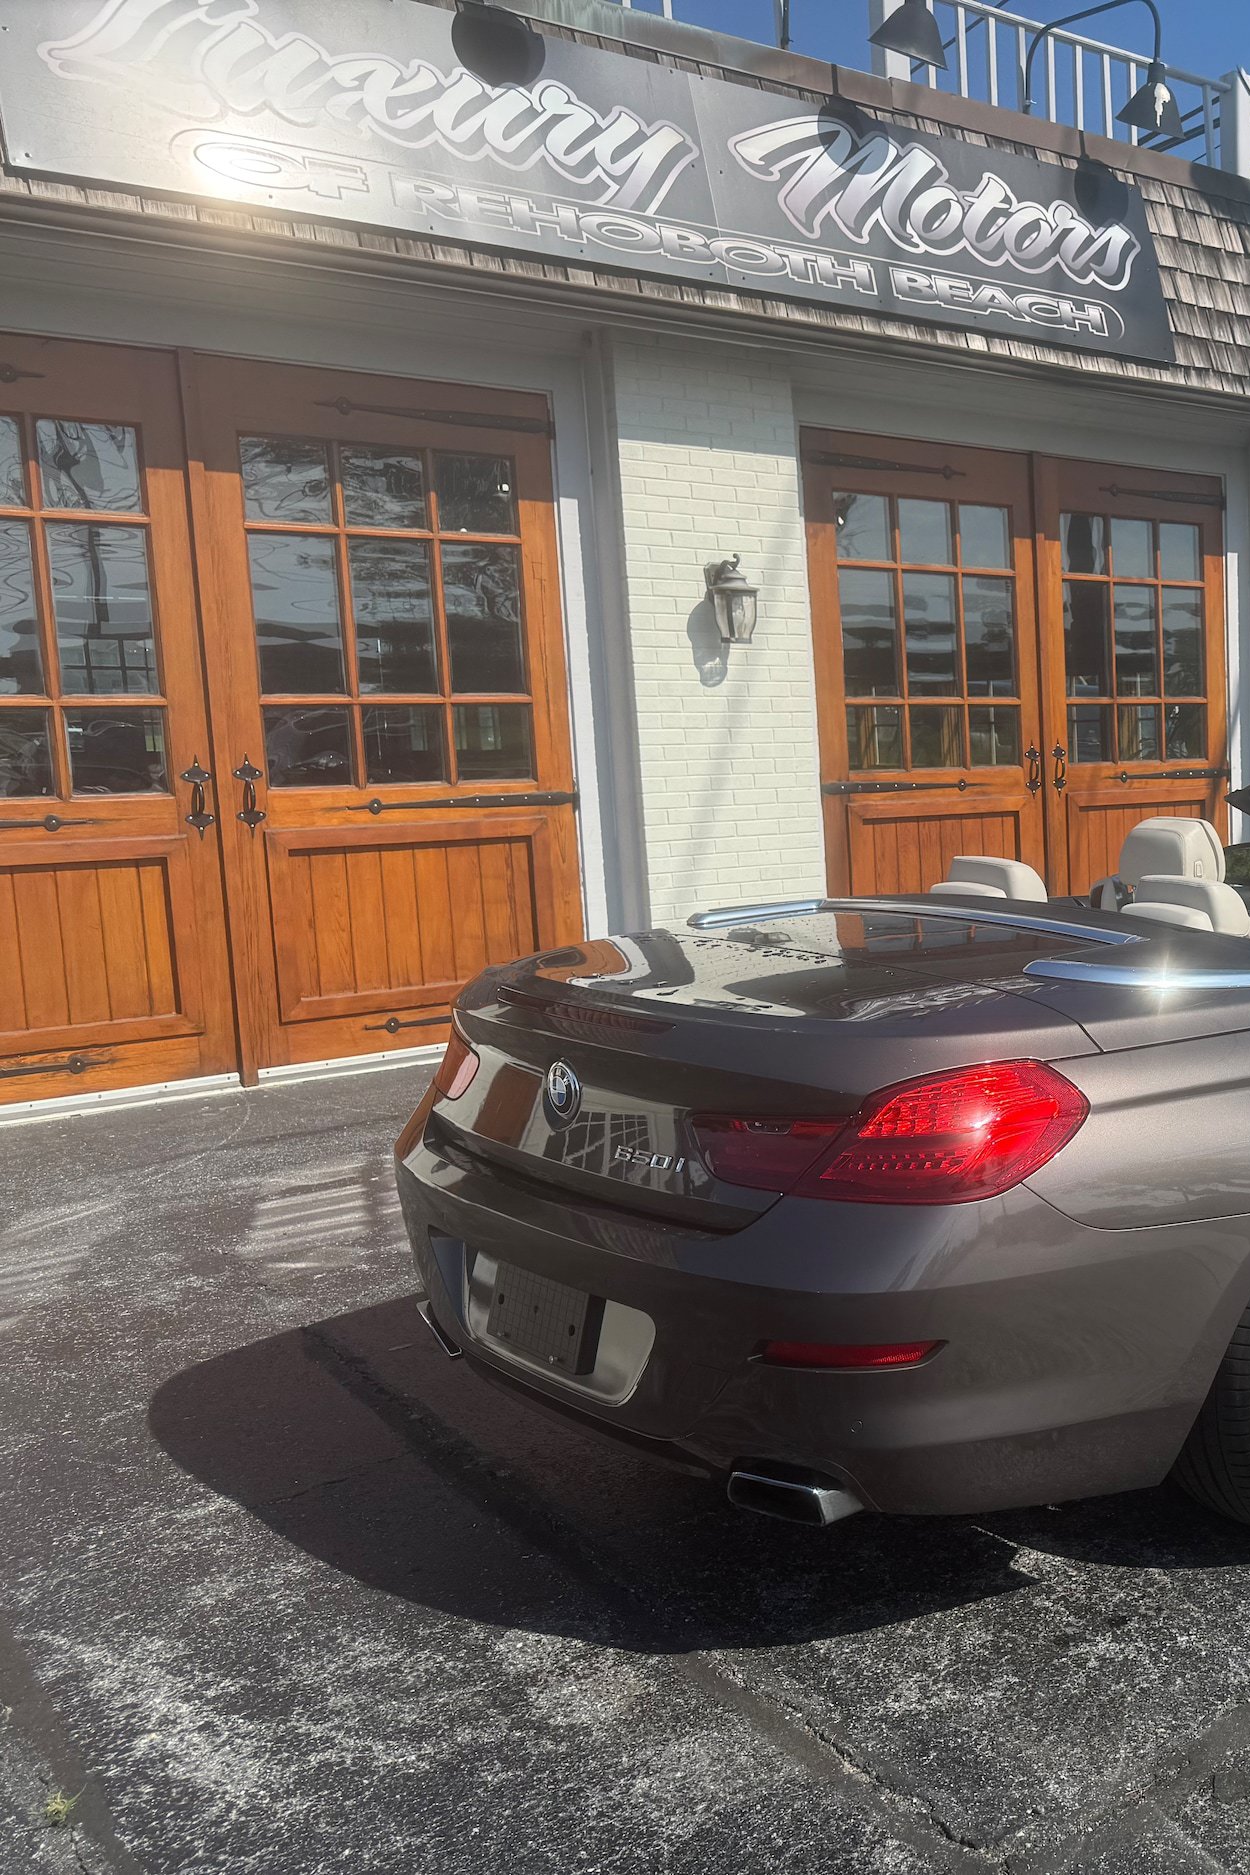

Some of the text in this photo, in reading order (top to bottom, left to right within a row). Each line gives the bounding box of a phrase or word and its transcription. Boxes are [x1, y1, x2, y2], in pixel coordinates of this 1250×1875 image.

[37, 0, 1141, 290] Luxury Motors
[193, 141, 1110, 337] OF REHOBOTH BEACH
